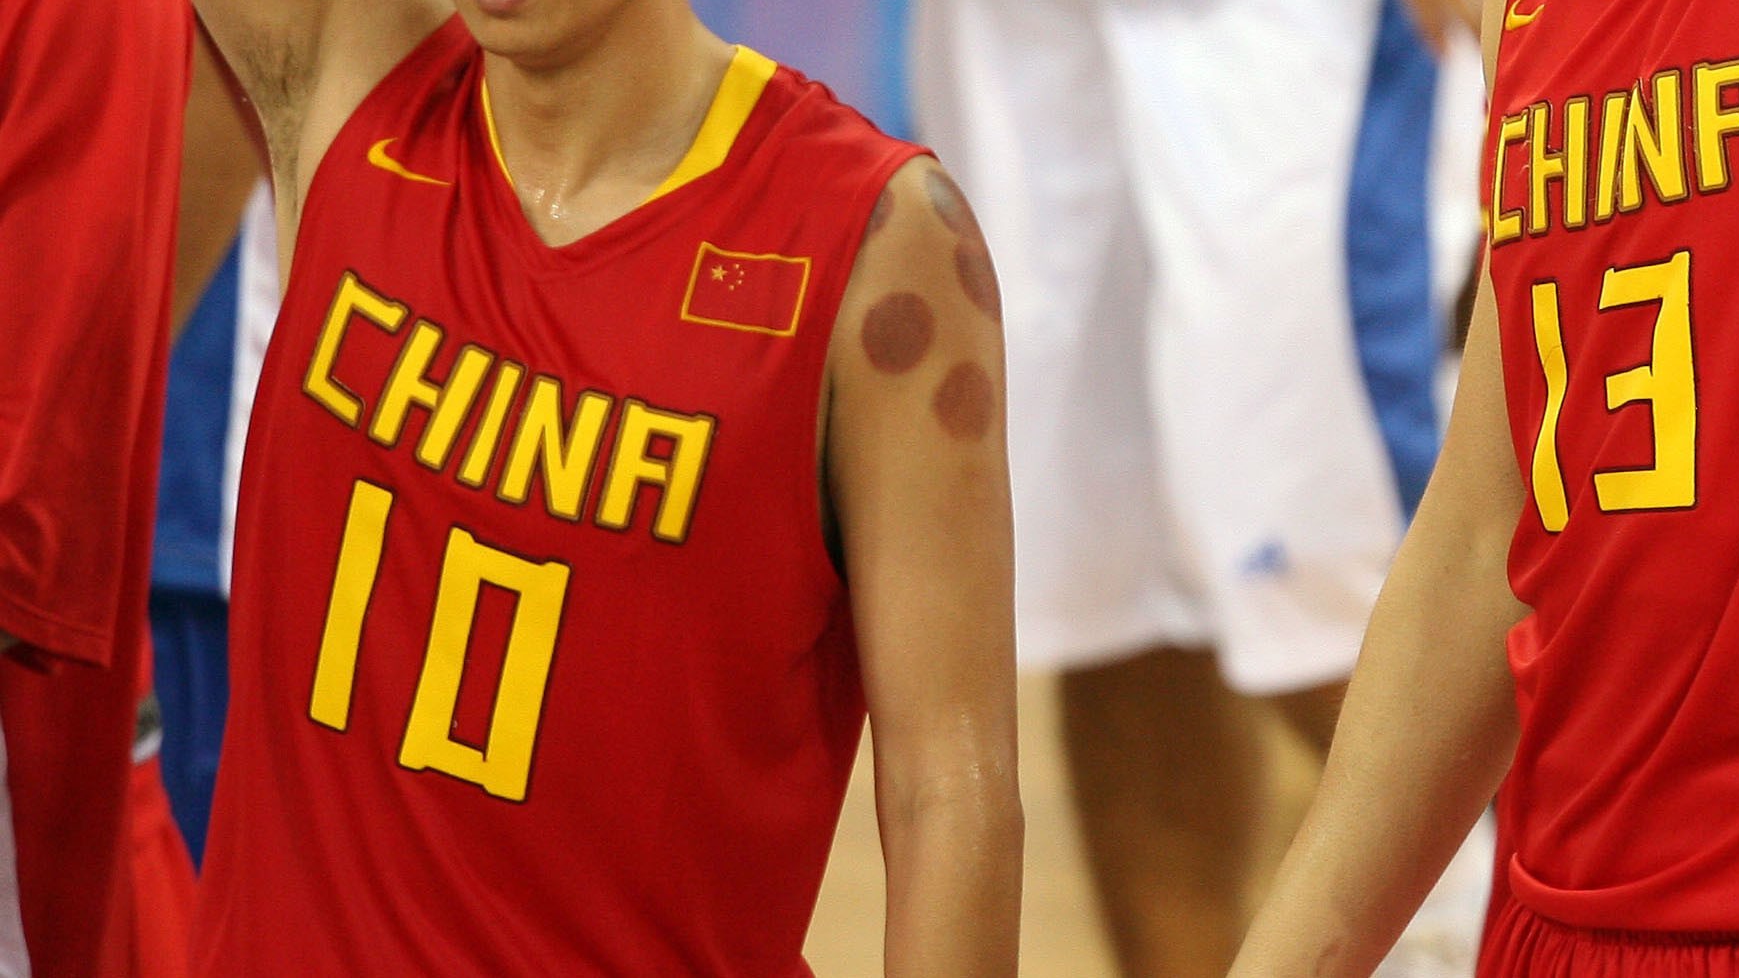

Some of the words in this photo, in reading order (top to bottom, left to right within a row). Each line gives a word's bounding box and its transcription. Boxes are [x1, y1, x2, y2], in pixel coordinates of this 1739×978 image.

[303, 269, 718, 544] CHINA
[1531, 250, 1697, 532] 13
[308, 478, 571, 803] 10
